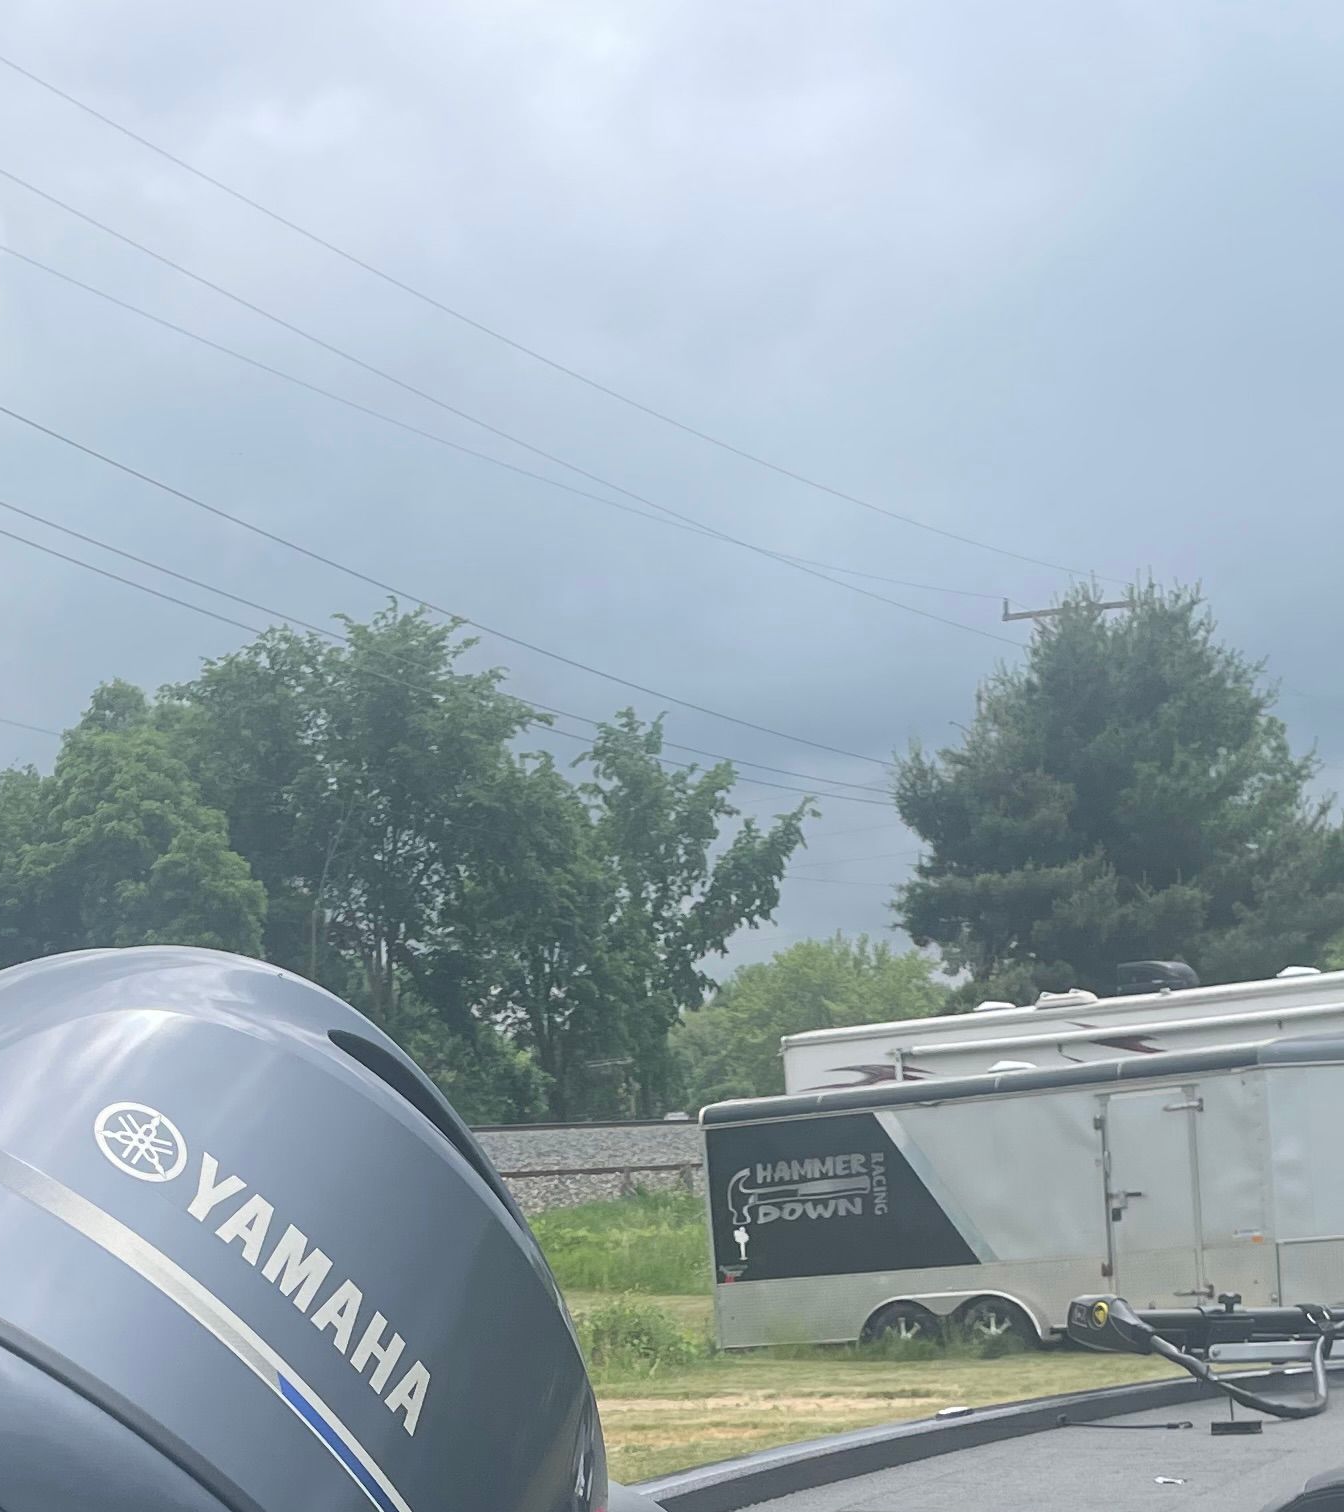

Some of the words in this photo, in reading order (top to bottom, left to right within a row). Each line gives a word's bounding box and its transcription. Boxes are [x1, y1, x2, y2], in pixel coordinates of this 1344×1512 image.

[756, 1153, 868, 1184] HAMMER
[871, 1152, 889, 1216] RACING
[757, 1197, 863, 1224] DOWN
[182, 1152, 432, 1436] YAMAHA
